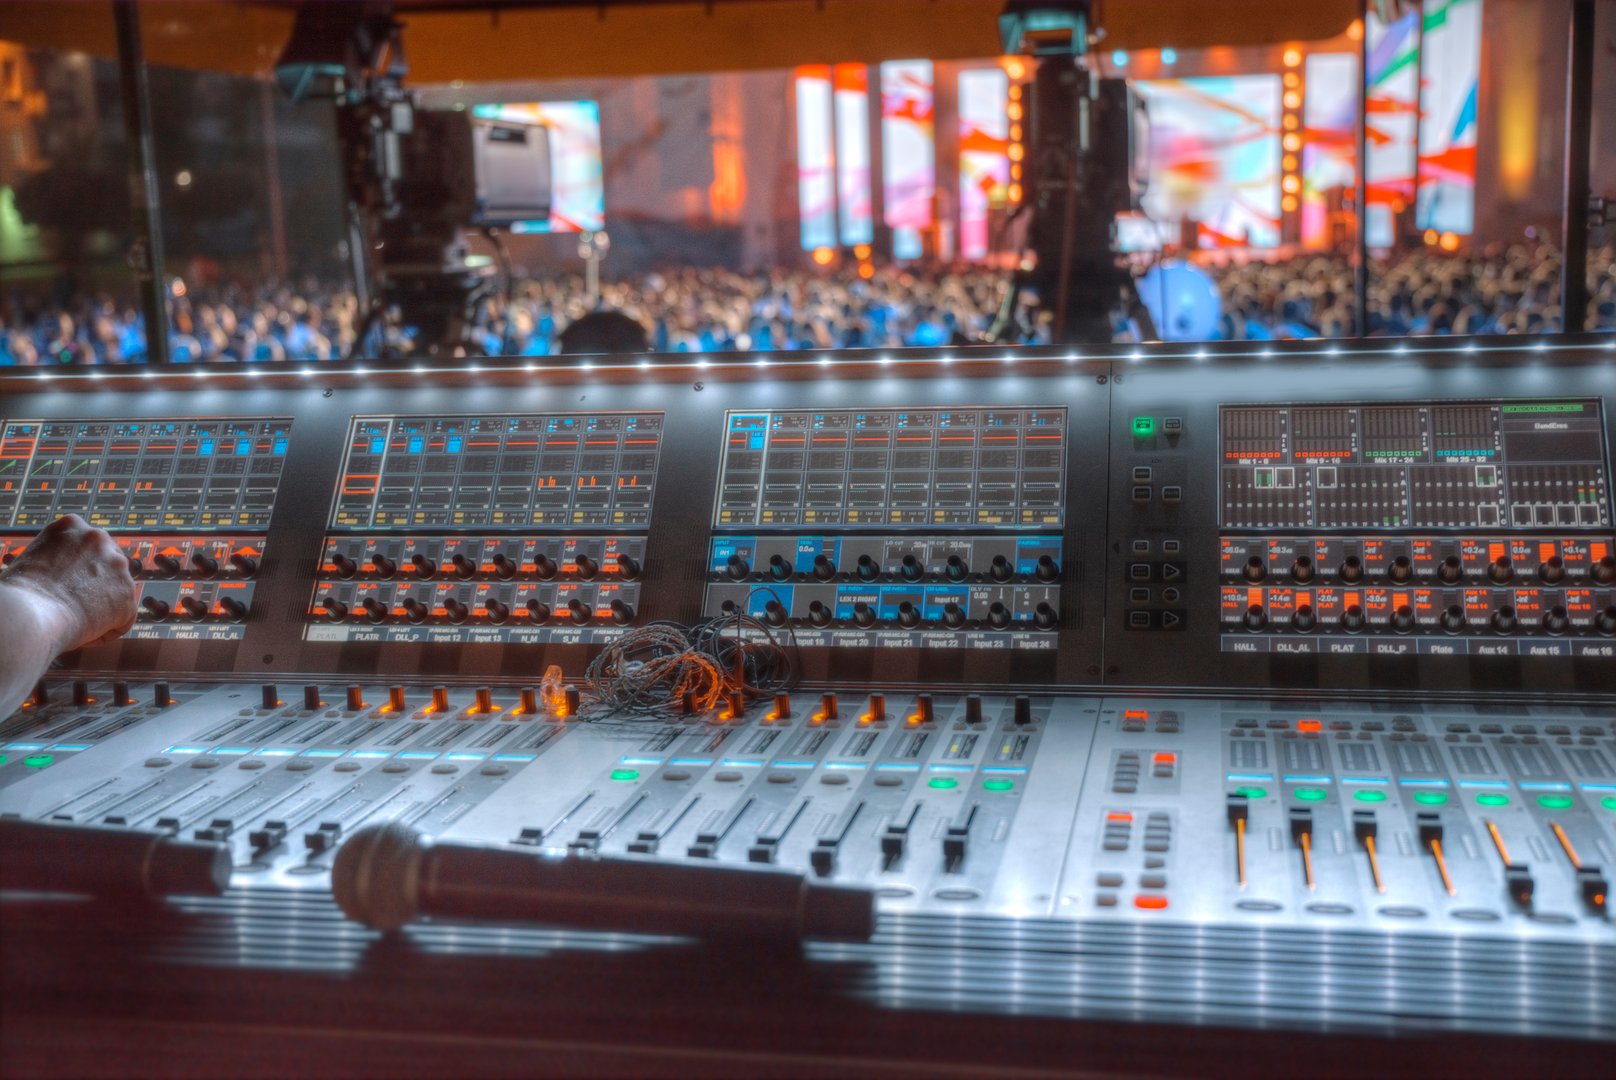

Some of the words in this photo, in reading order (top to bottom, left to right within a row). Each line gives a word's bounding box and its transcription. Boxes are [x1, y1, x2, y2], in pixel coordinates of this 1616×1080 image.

[213, 632, 238, 640] DLL_AL
[395, 634, 419, 642] DLL_P
[840, 639, 857, 647] Input
[884, 640, 902, 648] Input
[929, 640, 946, 648] Input
[974, 640, 992, 648] Input
[1234, 643, 1256, 651] HALL
[1277, 644, 1310, 652] DLL_AL
[1331, 644, 1355, 652] PLAT
[1378, 645, 1407, 654] DLL_P
[1431, 646, 1453, 654] Plate
[1479, 646, 1495, 654] Aux
[1497, 646, 1508, 654] 14
[1583, 647, 1599, 655] Aux
